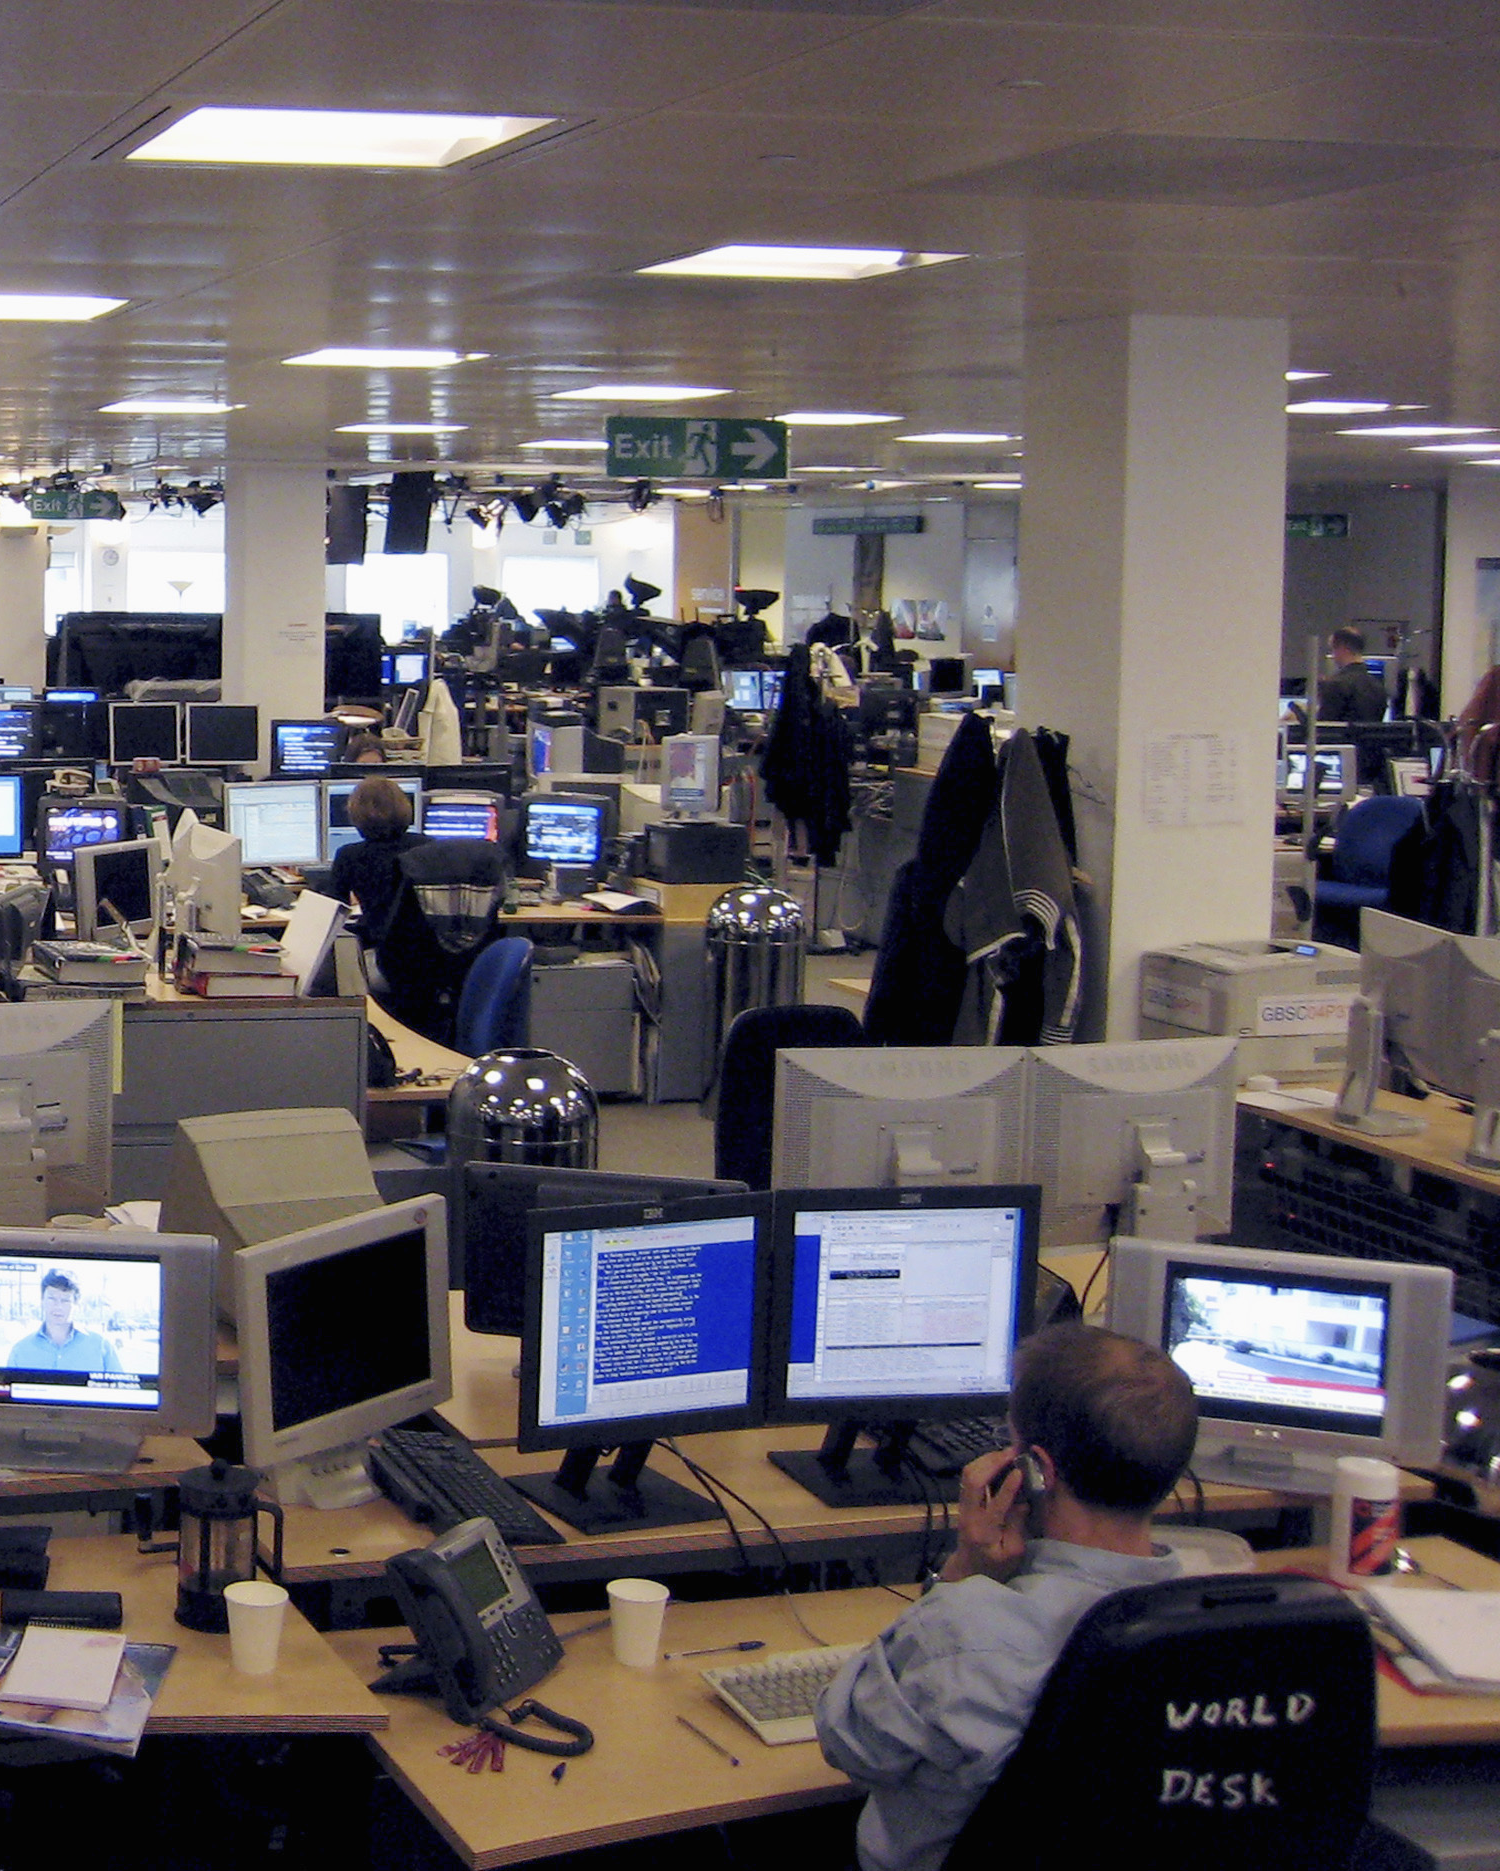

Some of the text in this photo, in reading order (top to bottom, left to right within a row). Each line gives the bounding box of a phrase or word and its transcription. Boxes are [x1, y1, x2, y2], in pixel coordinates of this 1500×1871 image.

[614, 434, 671, 459] Exit
[33, 499, 61, 512] Exit
[1165, 1692, 1316, 1730] WORLD
[1159, 1768, 1279, 1810] DESK
